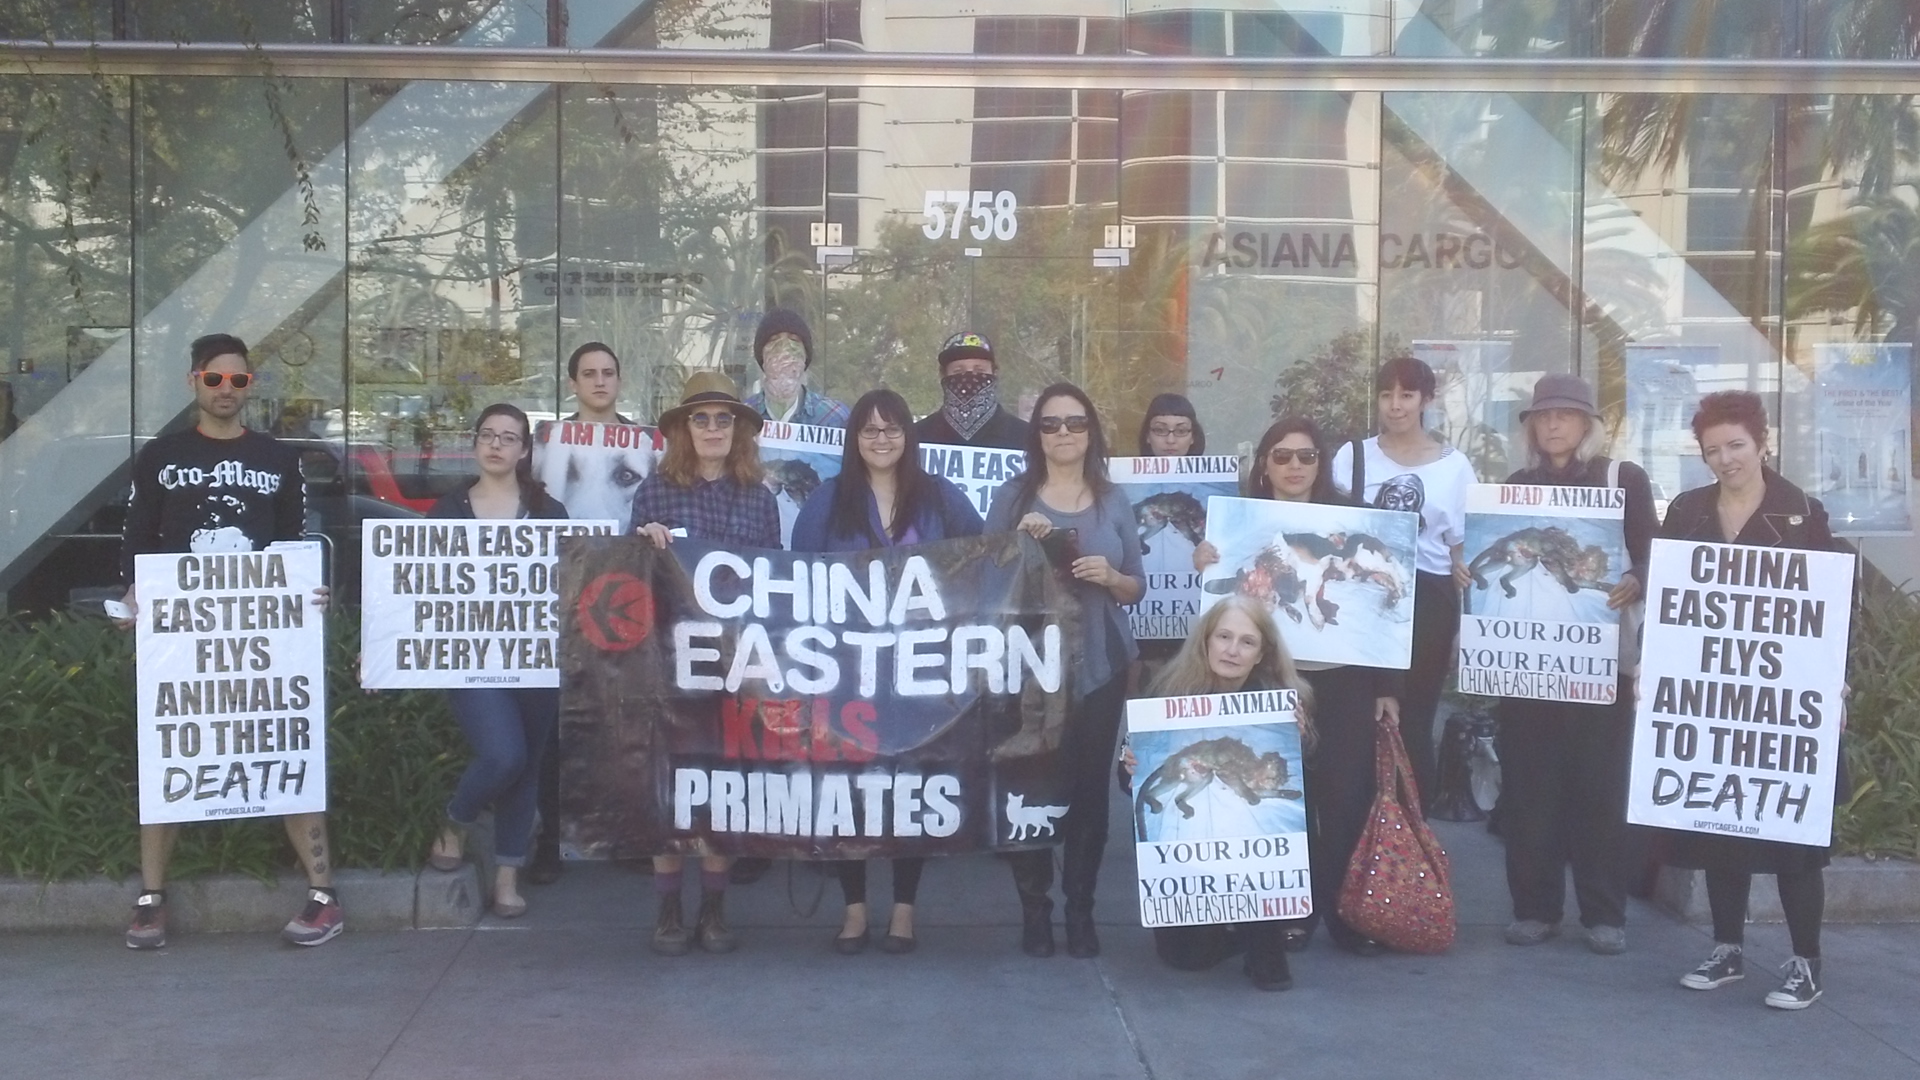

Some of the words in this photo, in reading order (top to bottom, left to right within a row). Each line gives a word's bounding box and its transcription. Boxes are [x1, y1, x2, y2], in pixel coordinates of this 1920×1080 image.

[922, 190, 1017, 240] 5758
[1202, 233, 1357, 268] ASIANA
[1381, 233, 1523, 269] CARGO
[560, 422, 594, 446] AM
[603, 426, 643, 449] NOT
[763, 422, 792, 440] EAD
[796, 425, 843, 446] ANIMA
[158, 460, 282, 495] Cro-Mags
[1133, 458, 1170, 475] DEAD
[1175, 457, 1238, 474] ANIMALS
[1500, 485, 1543, 506] DEAD
[1549, 488, 1624, 509] ANIMALS
[372, 524, 469, 558] CHINA
[177, 554, 287, 591] CHINA
[393, 562, 475, 595] KILLS
[1691, 545, 1809, 591] CHINA
[694, 551, 946, 626] CHINA
[152, 594, 303, 633] EASTERN
[1659, 587, 1825, 638] EASTERN
[1476, 619, 1546, 641] YOUR
[1553, 624, 1602, 645] JOB
[196, 636, 271, 673] FLYS
[397, 638, 490, 670] EVERY
[674, 622, 1061, 698] EASTERN
[1461, 648, 1530, 671] YOUR
[1538, 653, 1617, 677] FAULT
[1700, 636, 1783, 680] FLYS
[155, 675, 310, 717] ANIMALS
[465, 675, 520, 684] EMPTYCAGESLA.COM
[1570, 681, 1615, 702] KILLS
[1165, 697, 1212, 719] DEAD
[1219, 690, 1296, 716] ANIMALS
[1652, 676, 1823, 729] ANIMALS
[156, 722, 200, 758] TO
[210, 717, 310, 755] THEIR
[722, 698, 879, 762] KILLS
[1652, 721, 1698, 761] TO
[1709, 726, 1819, 775] THEIR
[163, 759, 307, 803] DEATH
[1652, 767, 1811, 824] DEATH
[205, 806, 265, 817] EMPTYCAGESLA.COM
[674, 768, 961, 838] PRIMATES
[1693, 820, 1760, 834] EMPTYCAGESLA.COM
[1155, 841, 1232, 864] YOUR
[1239, 837, 1290, 860] JOB
[1140, 875, 1217, 897] YOUR
[1225, 868, 1309, 893] FAULT
[1262, 895, 1310, 918] KILLS
